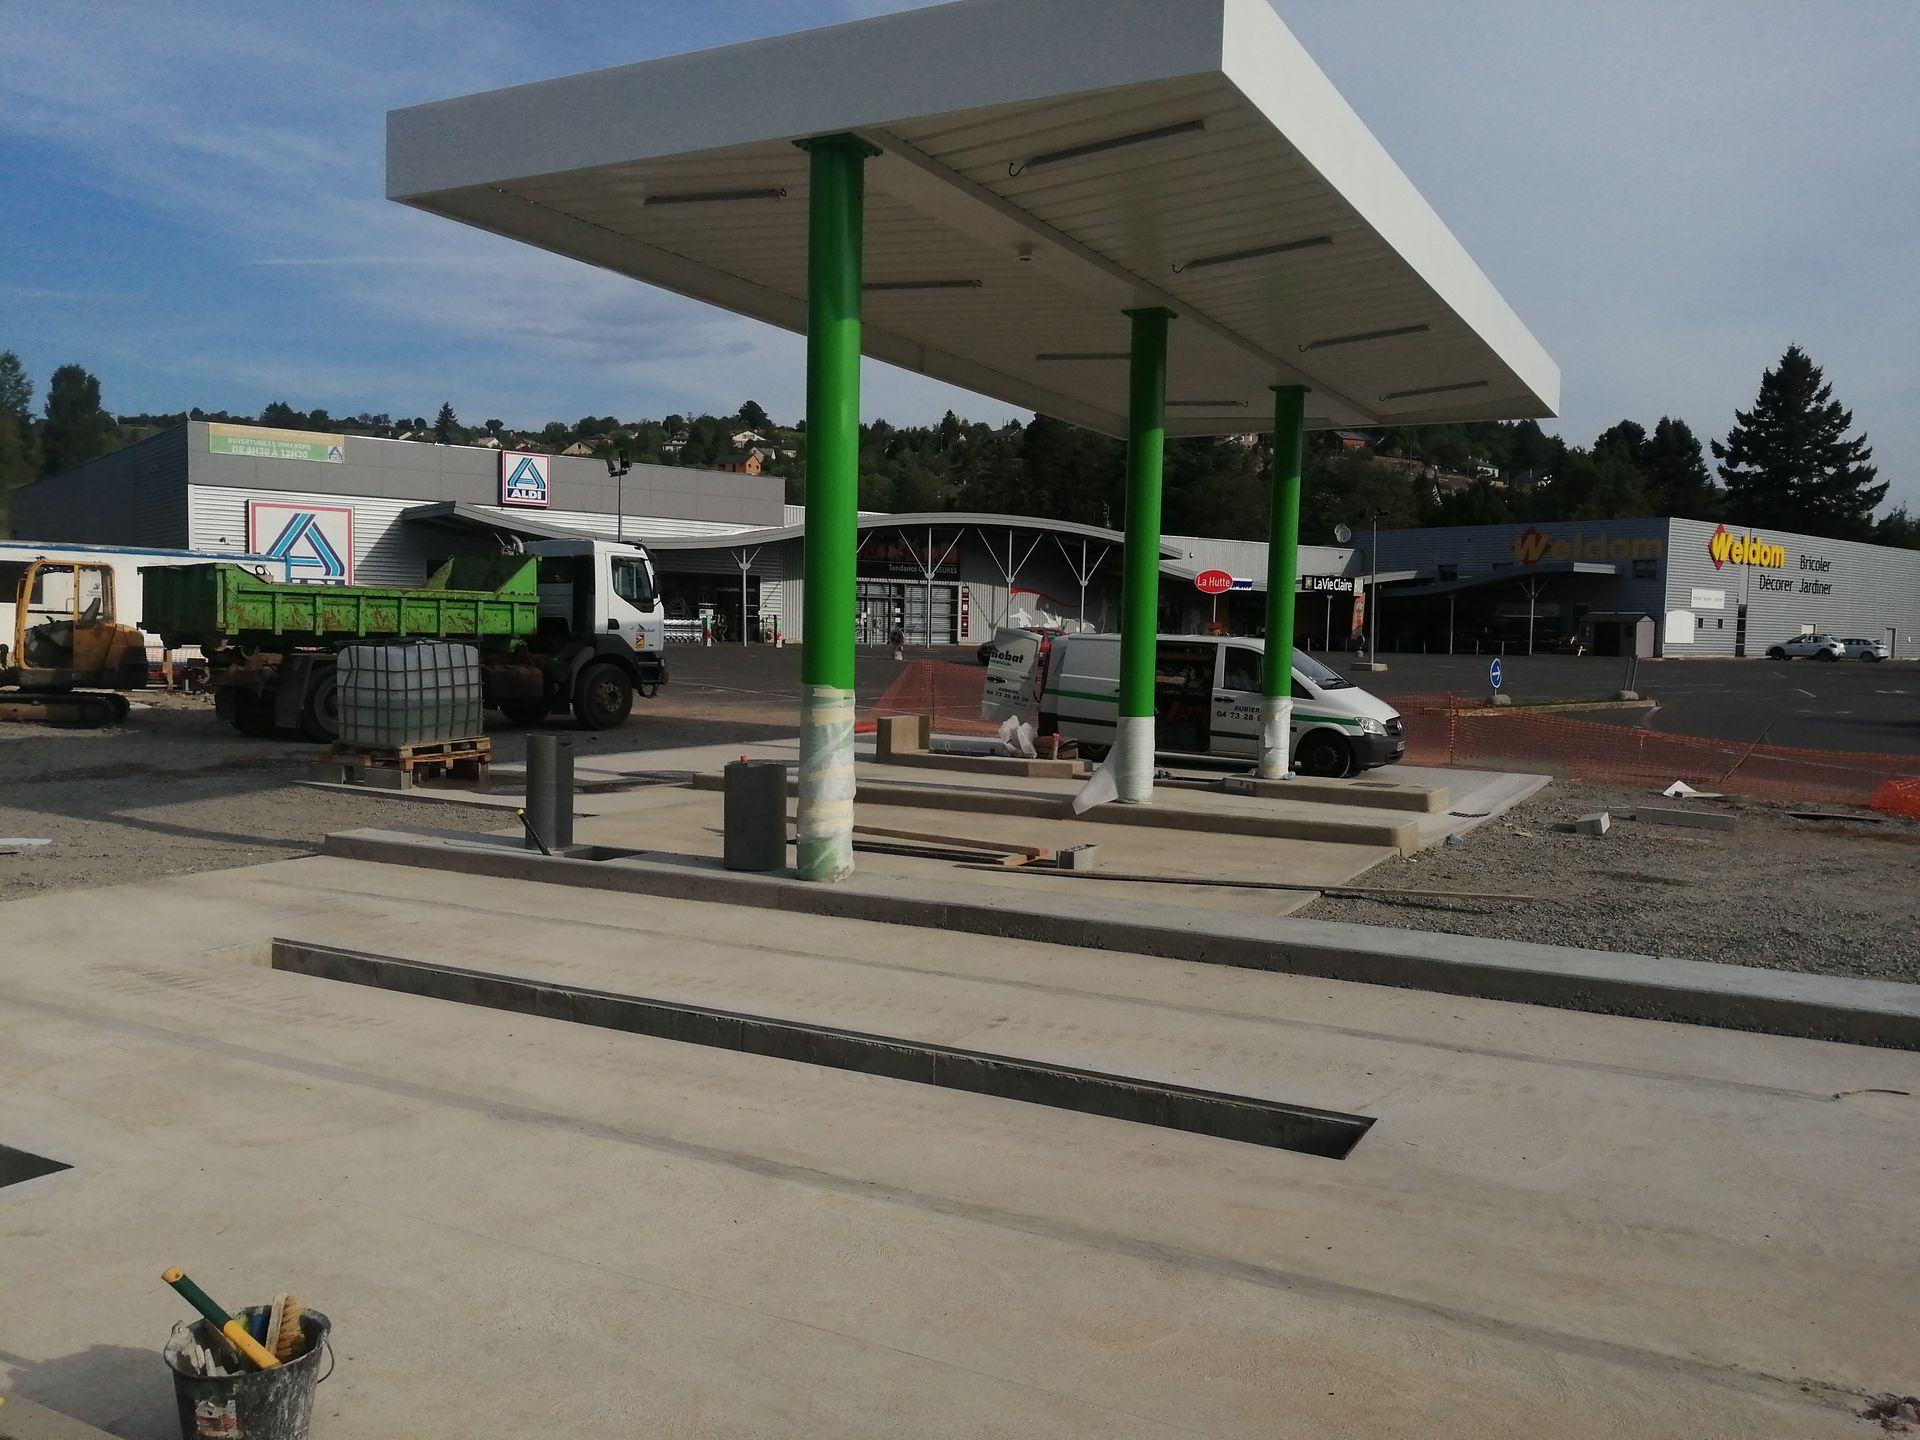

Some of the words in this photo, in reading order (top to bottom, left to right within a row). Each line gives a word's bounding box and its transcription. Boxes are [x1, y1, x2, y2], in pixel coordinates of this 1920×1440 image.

[231, 445, 242, 454] DE
[280, 449, 308, 459] 12H30
[510, 489, 542, 500] ALDI
[1513, 532, 1664, 561] Weldom
[1711, 532, 1785, 569] Weldom
[888, 563, 918, 573] Tendance
[1799, 554, 1832, 573] Bricoler
[1197, 576, 1207, 587] La
[1209, 576, 1231, 587] Hutte
[1759, 574, 1794, 592] Décorer
[1799, 577, 1833, 595] Jardiner
[1216, 710, 1227, 718] 04
[1230, 711, 1240, 719] 73
[1234, 705, 1261, 714] AUBIER
